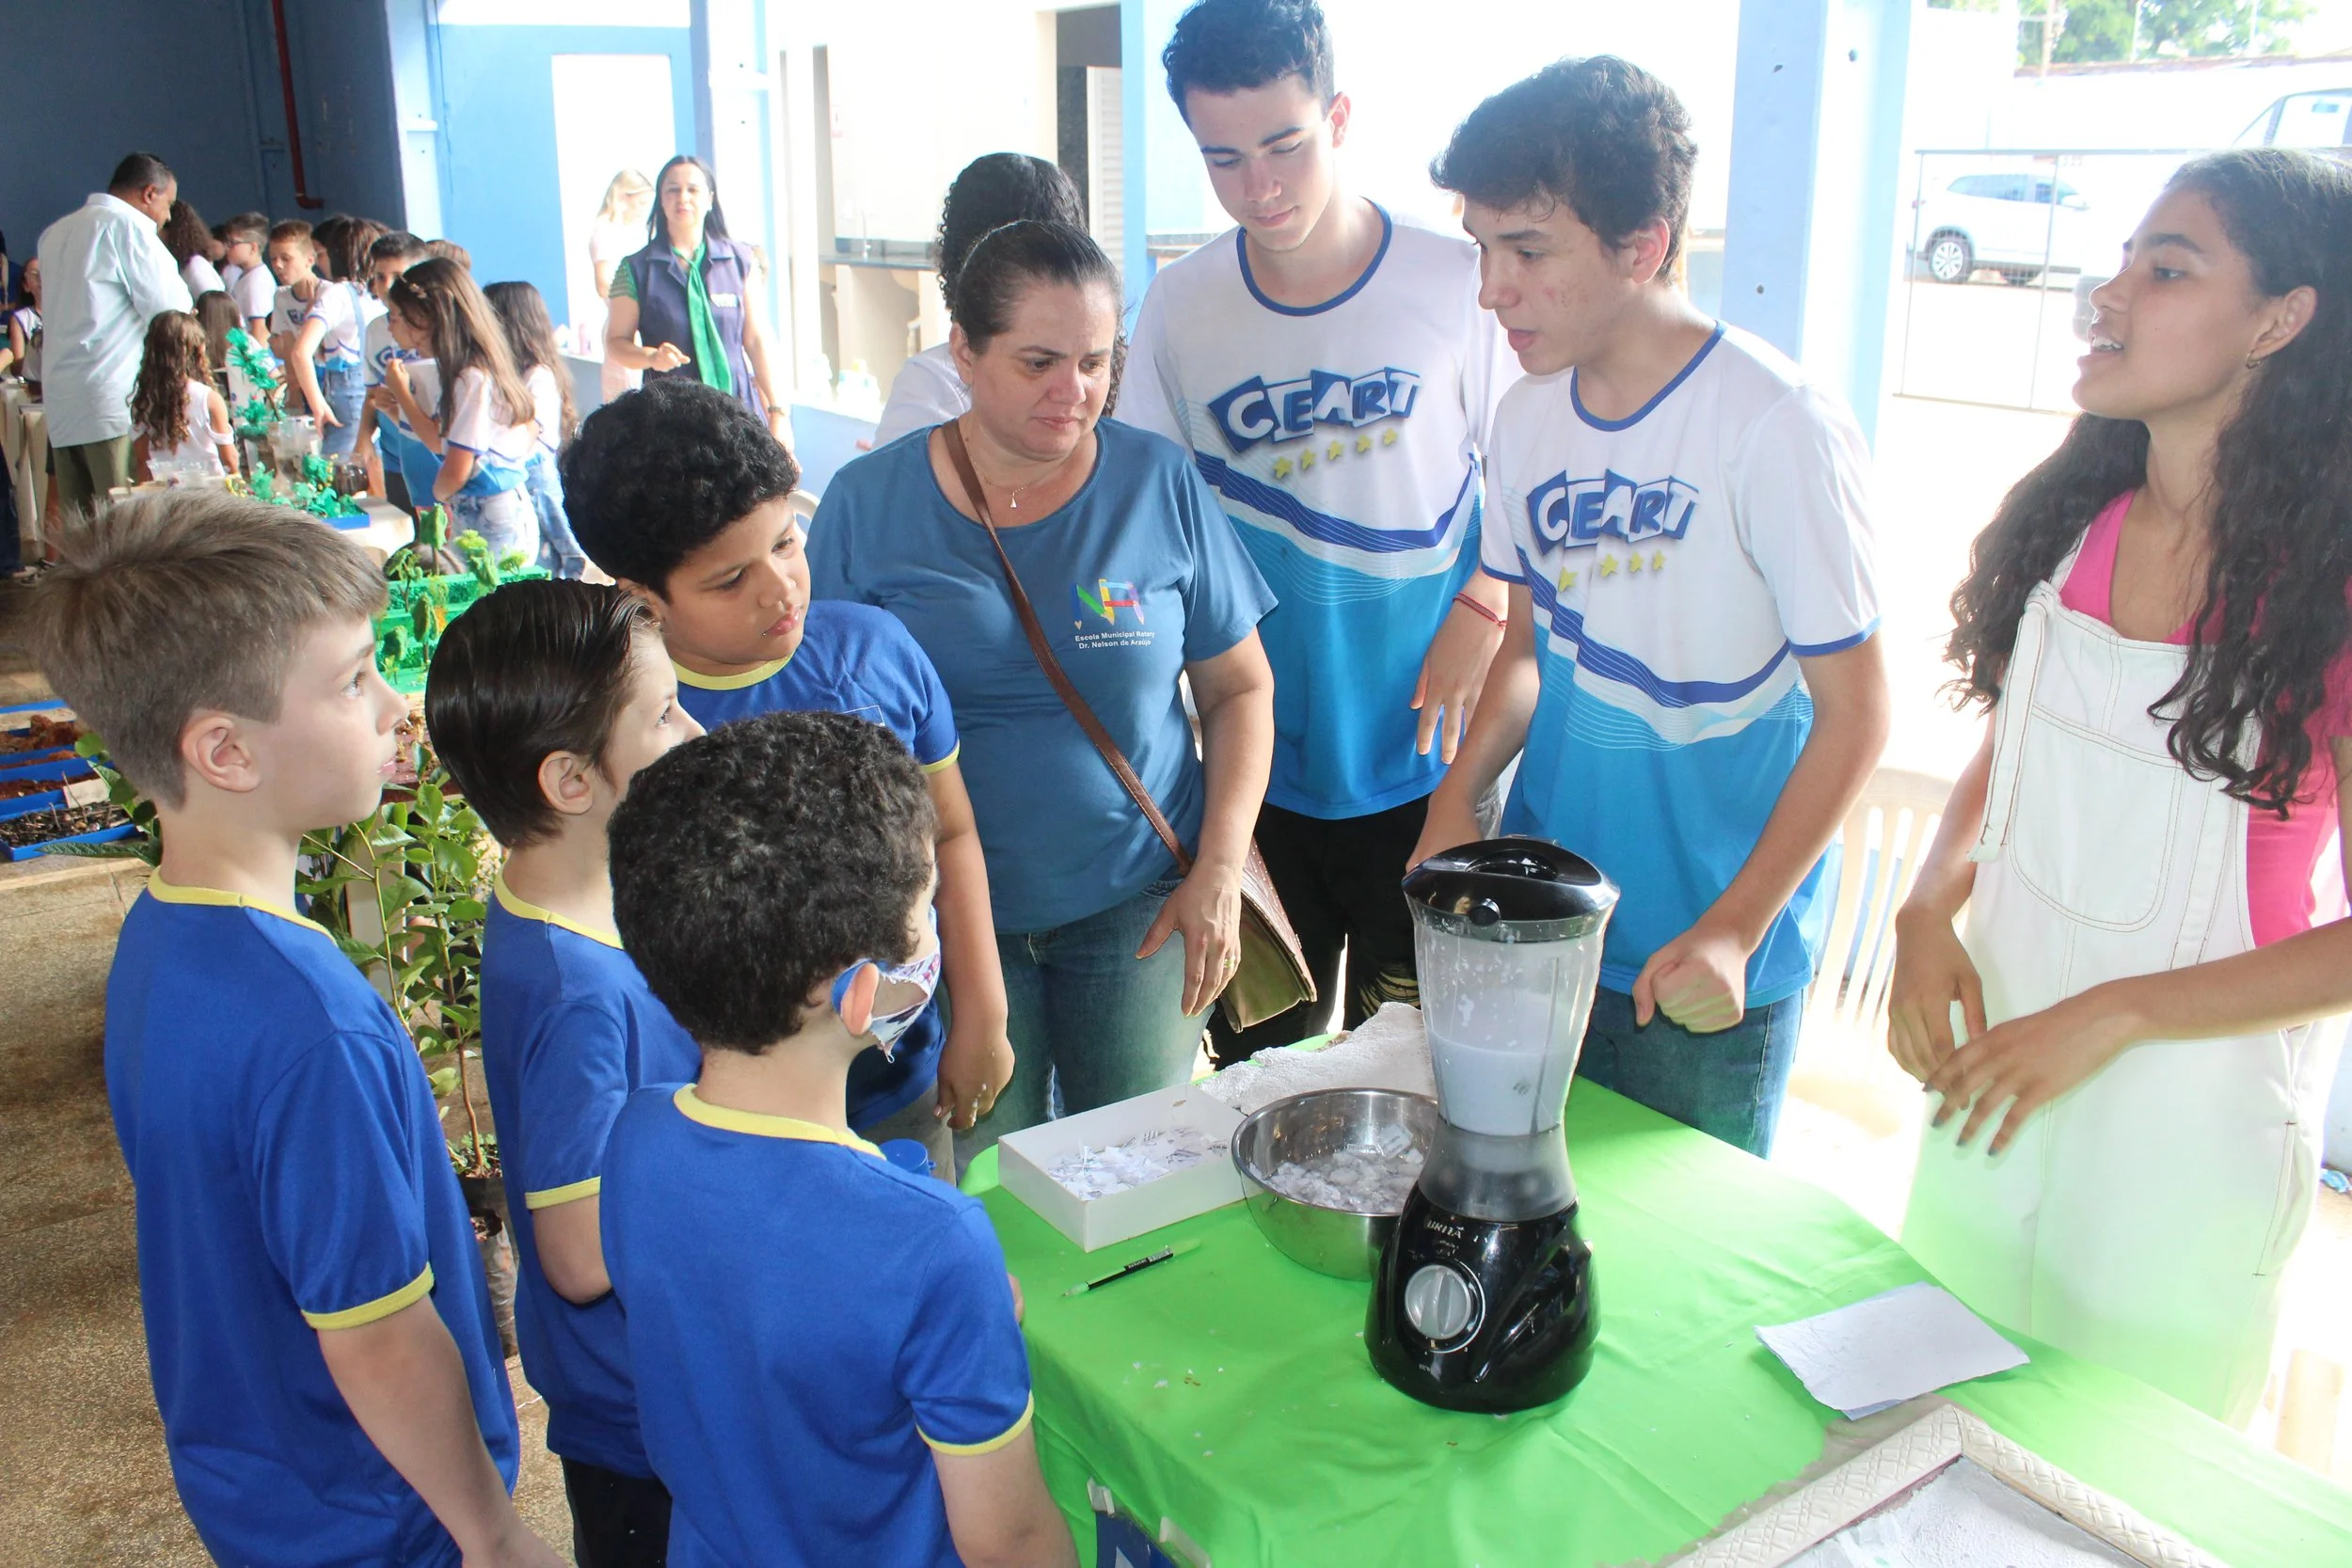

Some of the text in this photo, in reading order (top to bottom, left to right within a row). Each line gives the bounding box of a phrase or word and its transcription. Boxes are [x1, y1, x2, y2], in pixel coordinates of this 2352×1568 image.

[1224, 369, 1423, 441] CEART
[1535, 478, 1701, 544] CEART
[1074, 630, 1155, 641] Escola Municipal Rotary
[1130, 639, 1152, 647] Araújo
